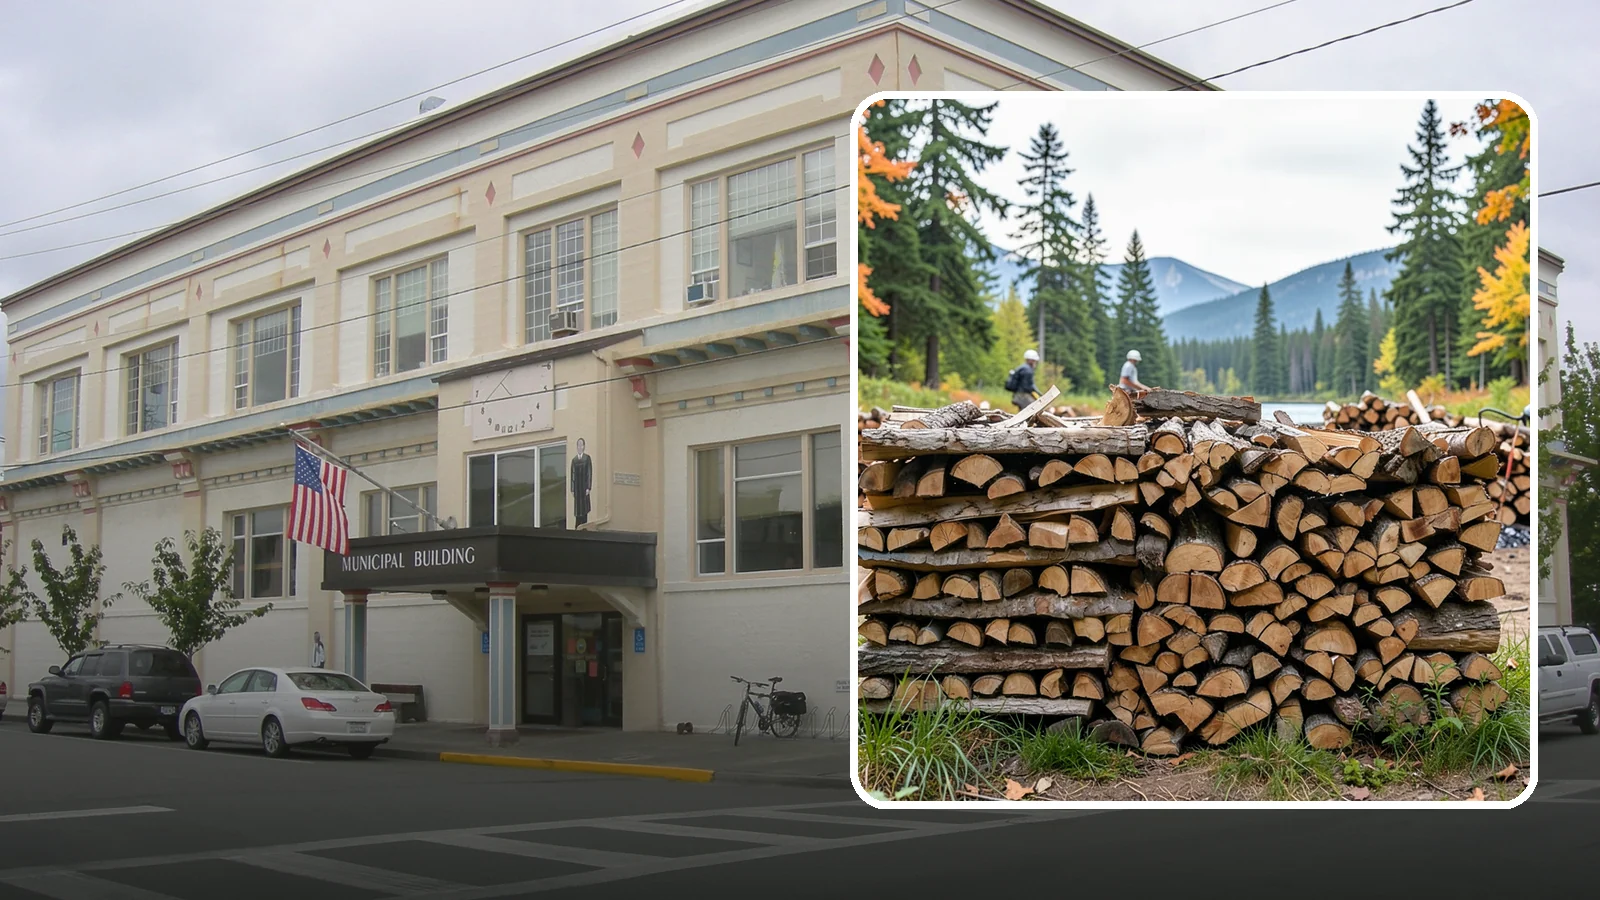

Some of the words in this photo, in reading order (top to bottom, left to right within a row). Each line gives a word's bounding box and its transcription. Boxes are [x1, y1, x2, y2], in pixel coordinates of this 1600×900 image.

[547, 362, 552, 370] 6
[475, 390, 479, 398] 7
[536, 402, 540, 410] 4
[481, 407, 484, 415] 8
[488, 418, 492, 426] 9
[528, 414, 533, 422] 3
[494, 424, 500, 432] 10
[521, 420, 525, 428] 2
[508, 425, 513, 433] 12
[342, 552, 405, 572] MUNICIPAL
[414, 546, 475, 567] BUILDING
